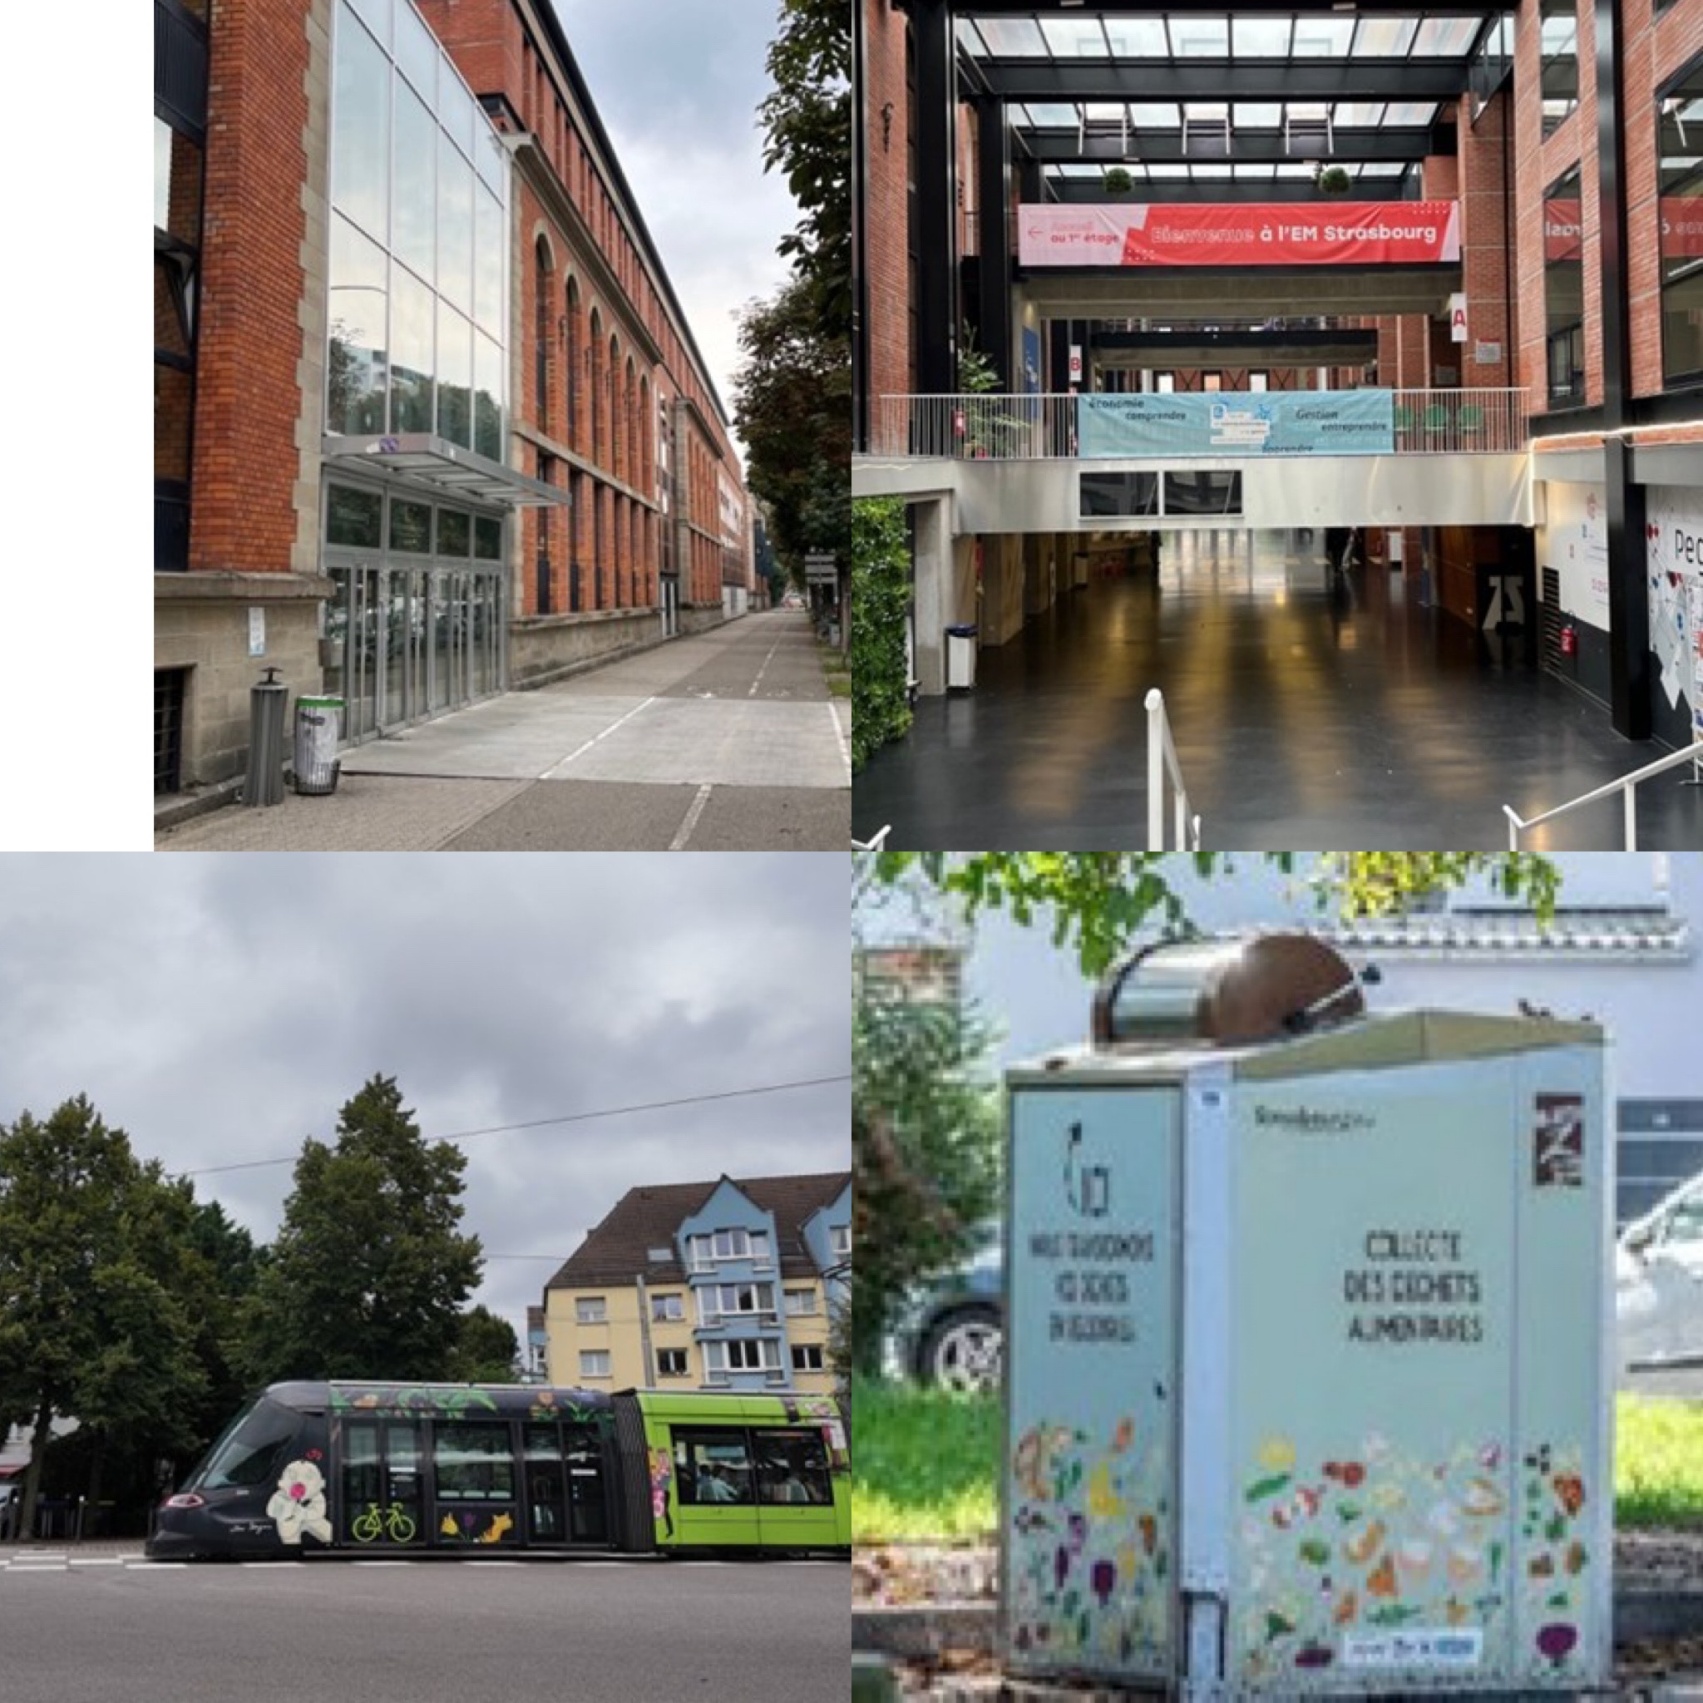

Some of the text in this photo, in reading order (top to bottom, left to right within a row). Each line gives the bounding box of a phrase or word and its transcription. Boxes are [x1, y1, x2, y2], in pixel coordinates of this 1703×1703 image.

[1152, 224, 1254, 243] Bienvenue
[1260, 225, 1273, 241] à
[1324, 223, 1436, 243] Strasbourg
[1453, 309, 1466, 327] A
[1295, 409, 1339, 421] Gestion
[1321, 420, 1387, 432] entreprendre
[1366, 1231, 1461, 1262] COLLECTE
[1344, 1271, 1385, 1302] DES
